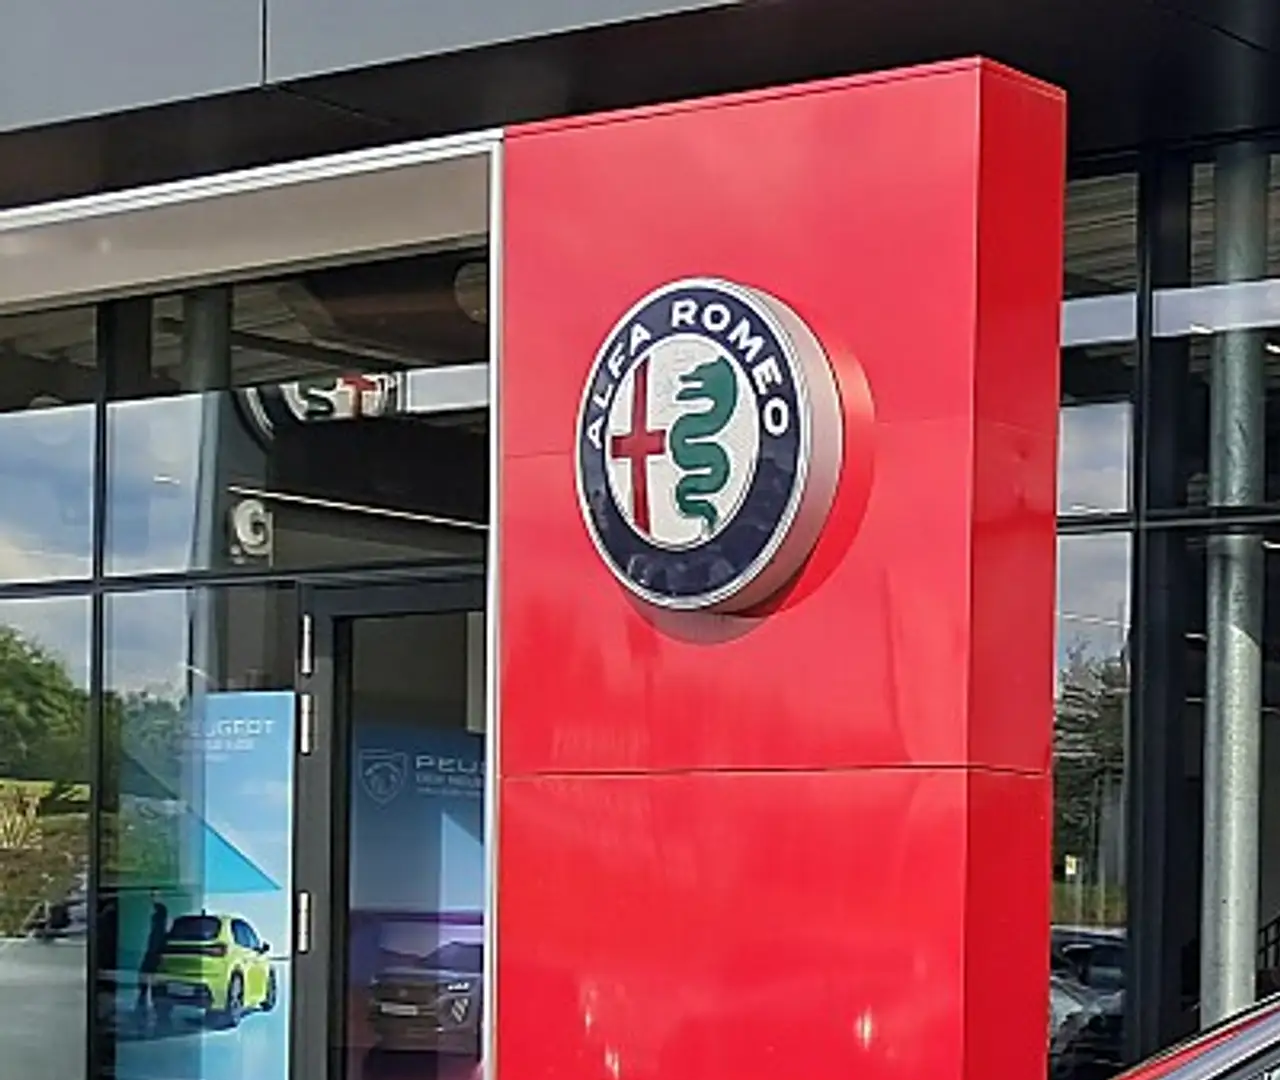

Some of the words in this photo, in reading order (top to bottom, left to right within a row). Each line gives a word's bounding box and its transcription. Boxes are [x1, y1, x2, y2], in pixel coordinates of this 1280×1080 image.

[585, 325, 653, 450] ALFA
[670, 299, 791, 437] ROMEO
[415, 754, 486, 774] PEU
